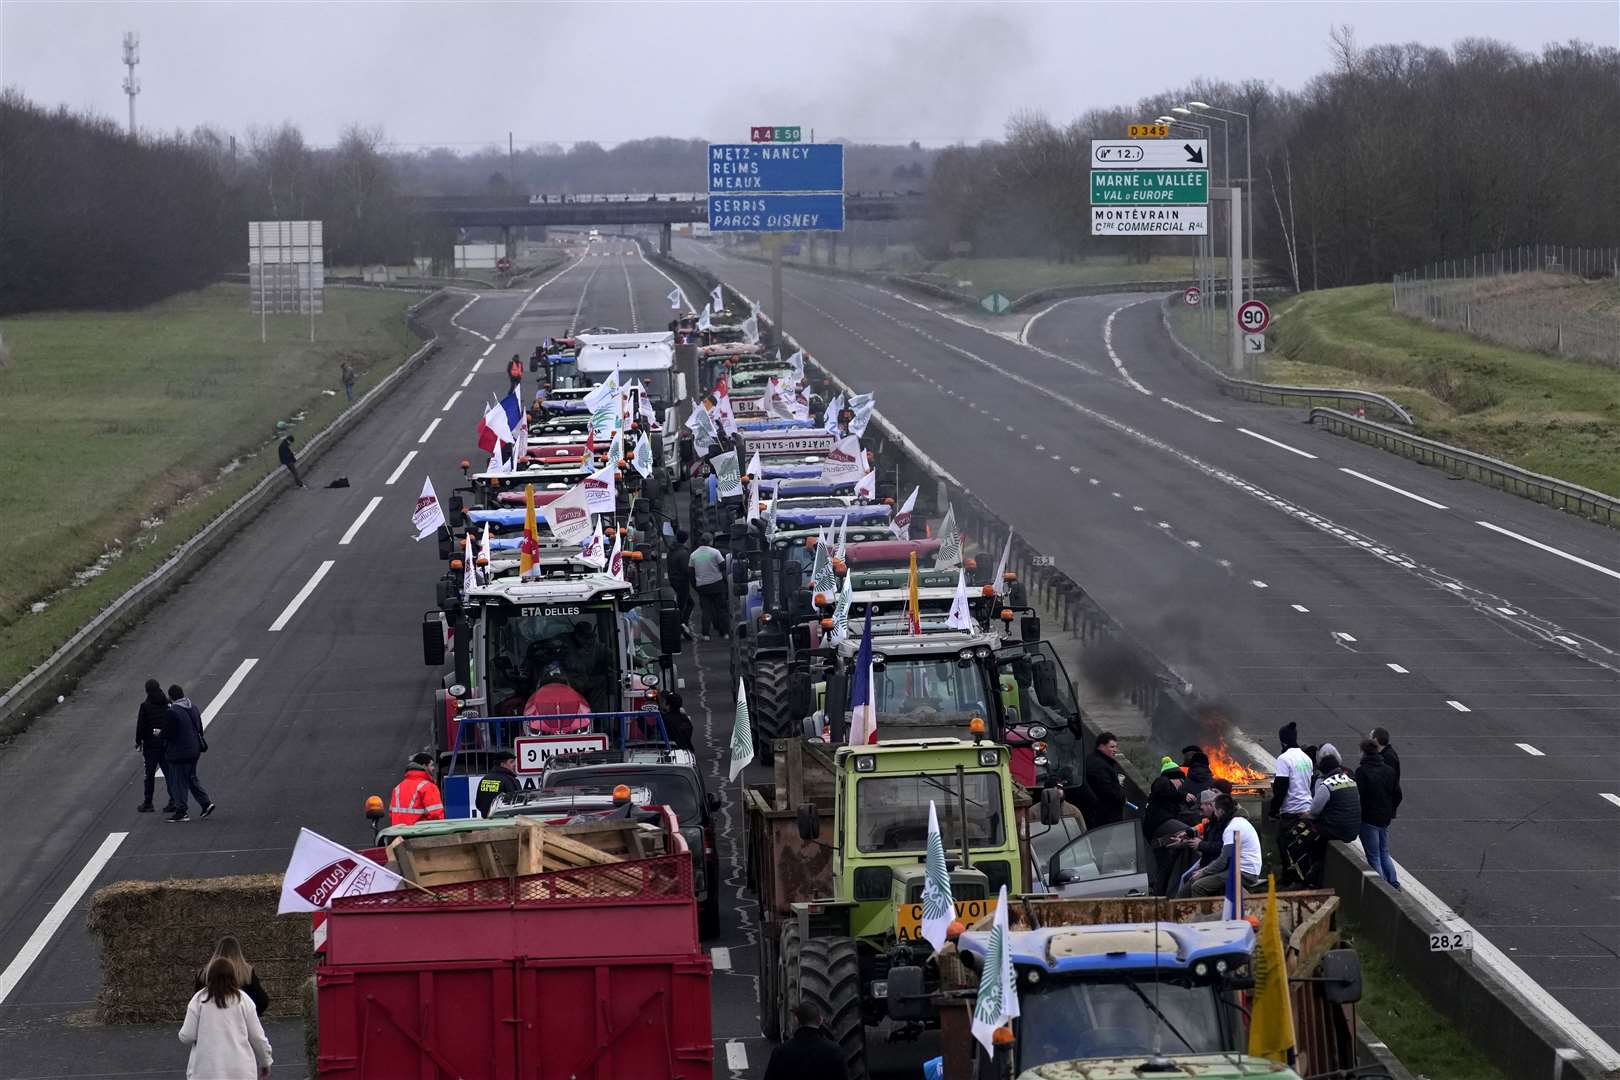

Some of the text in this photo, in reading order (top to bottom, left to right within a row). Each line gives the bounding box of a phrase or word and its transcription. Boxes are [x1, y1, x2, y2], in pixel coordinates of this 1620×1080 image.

[753, 130, 771, 139] A 4
[774, 130, 800, 139] E 50
[1131, 127, 1165, 135] D 345
[713, 162, 759, 174] REIMS
[713, 177, 761, 188] MEAUX
[1096, 175, 1140, 186] MARNE
[1156, 173, 1203, 186] VALLÉE
[1104, 190, 1123, 200] VAL
[714, 200, 766, 212] SERRIS
[1095, 209, 1179, 220] MONTÉVRAIN
[714, 214, 819, 227] PARCS DISNEY
[1117, 222, 1184, 231] COMMERCIAL
[1244, 310, 1263, 324] 90
[749, 440, 831, 450] CHÂTEAU-SALINS
[521, 607, 580, 617] ETA DELLES
[912, 902, 987, 921] CVOI
[1431, 934, 1463, 950] 28,2
